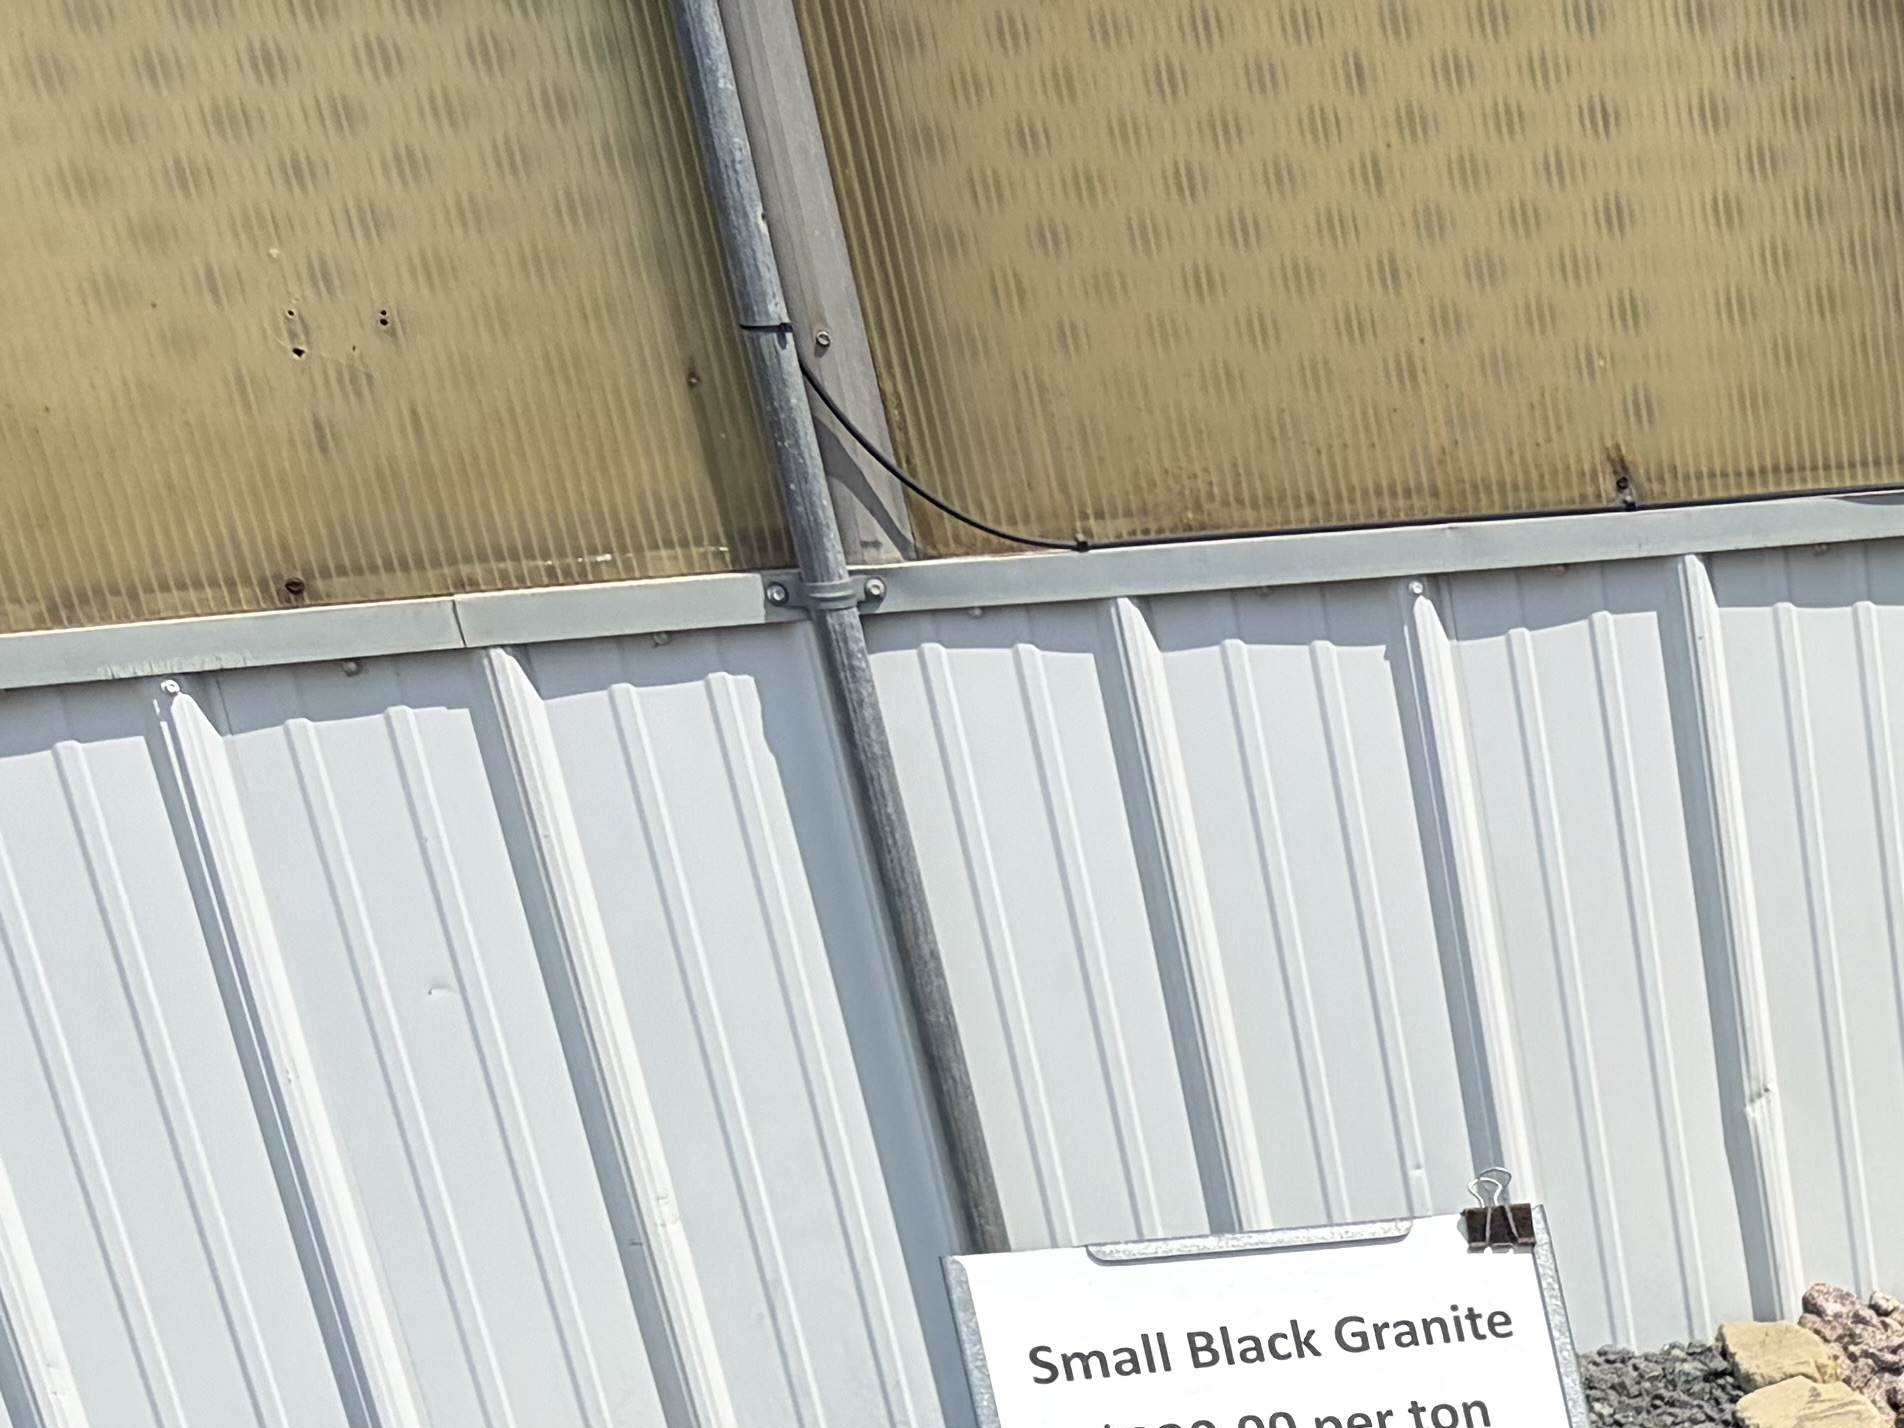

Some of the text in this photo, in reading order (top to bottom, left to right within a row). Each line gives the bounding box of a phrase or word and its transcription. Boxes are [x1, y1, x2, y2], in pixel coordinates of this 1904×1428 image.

[1028, 1304, 1514, 1385] Small Black Granite
